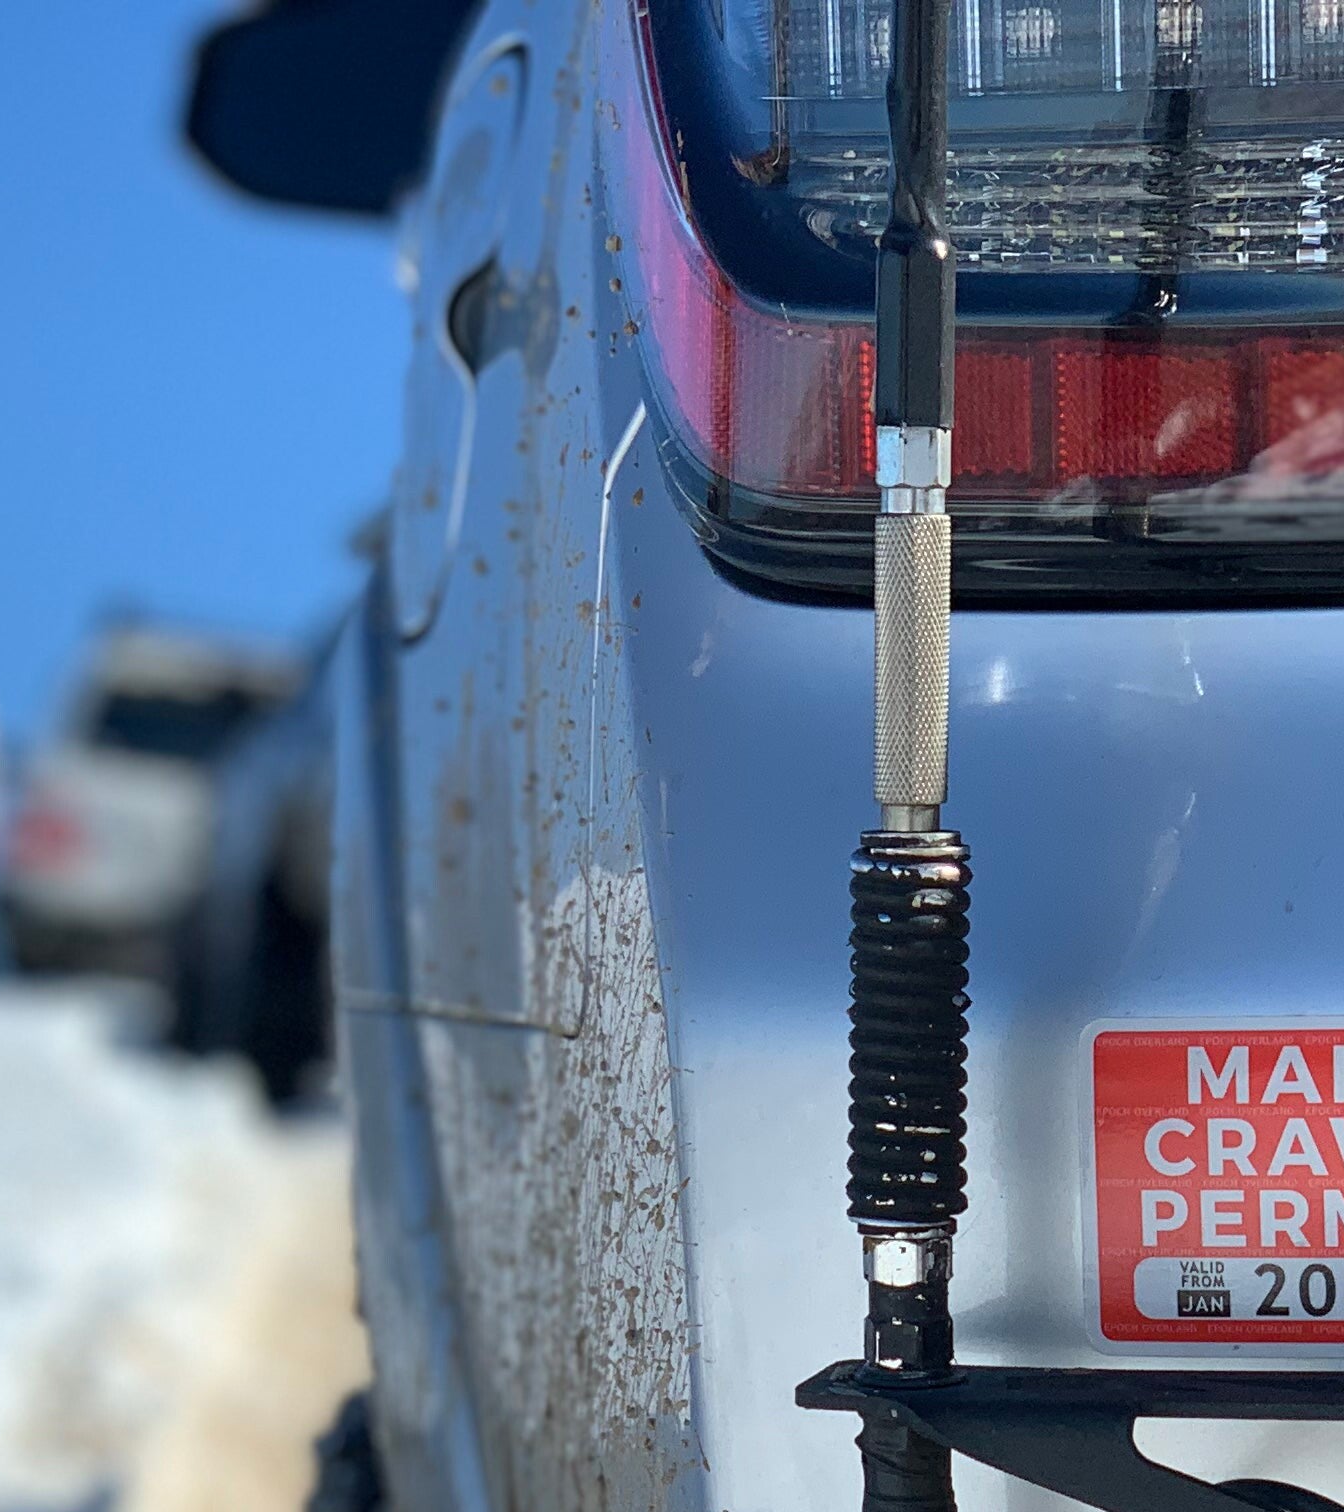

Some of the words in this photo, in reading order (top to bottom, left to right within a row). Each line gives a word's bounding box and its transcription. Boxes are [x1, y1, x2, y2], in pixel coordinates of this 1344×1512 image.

[1179, 1261, 1225, 1274] VALID
[1181, 1275, 1225, 1288] FROM
[1182, 1295, 1224, 1313] JAN
